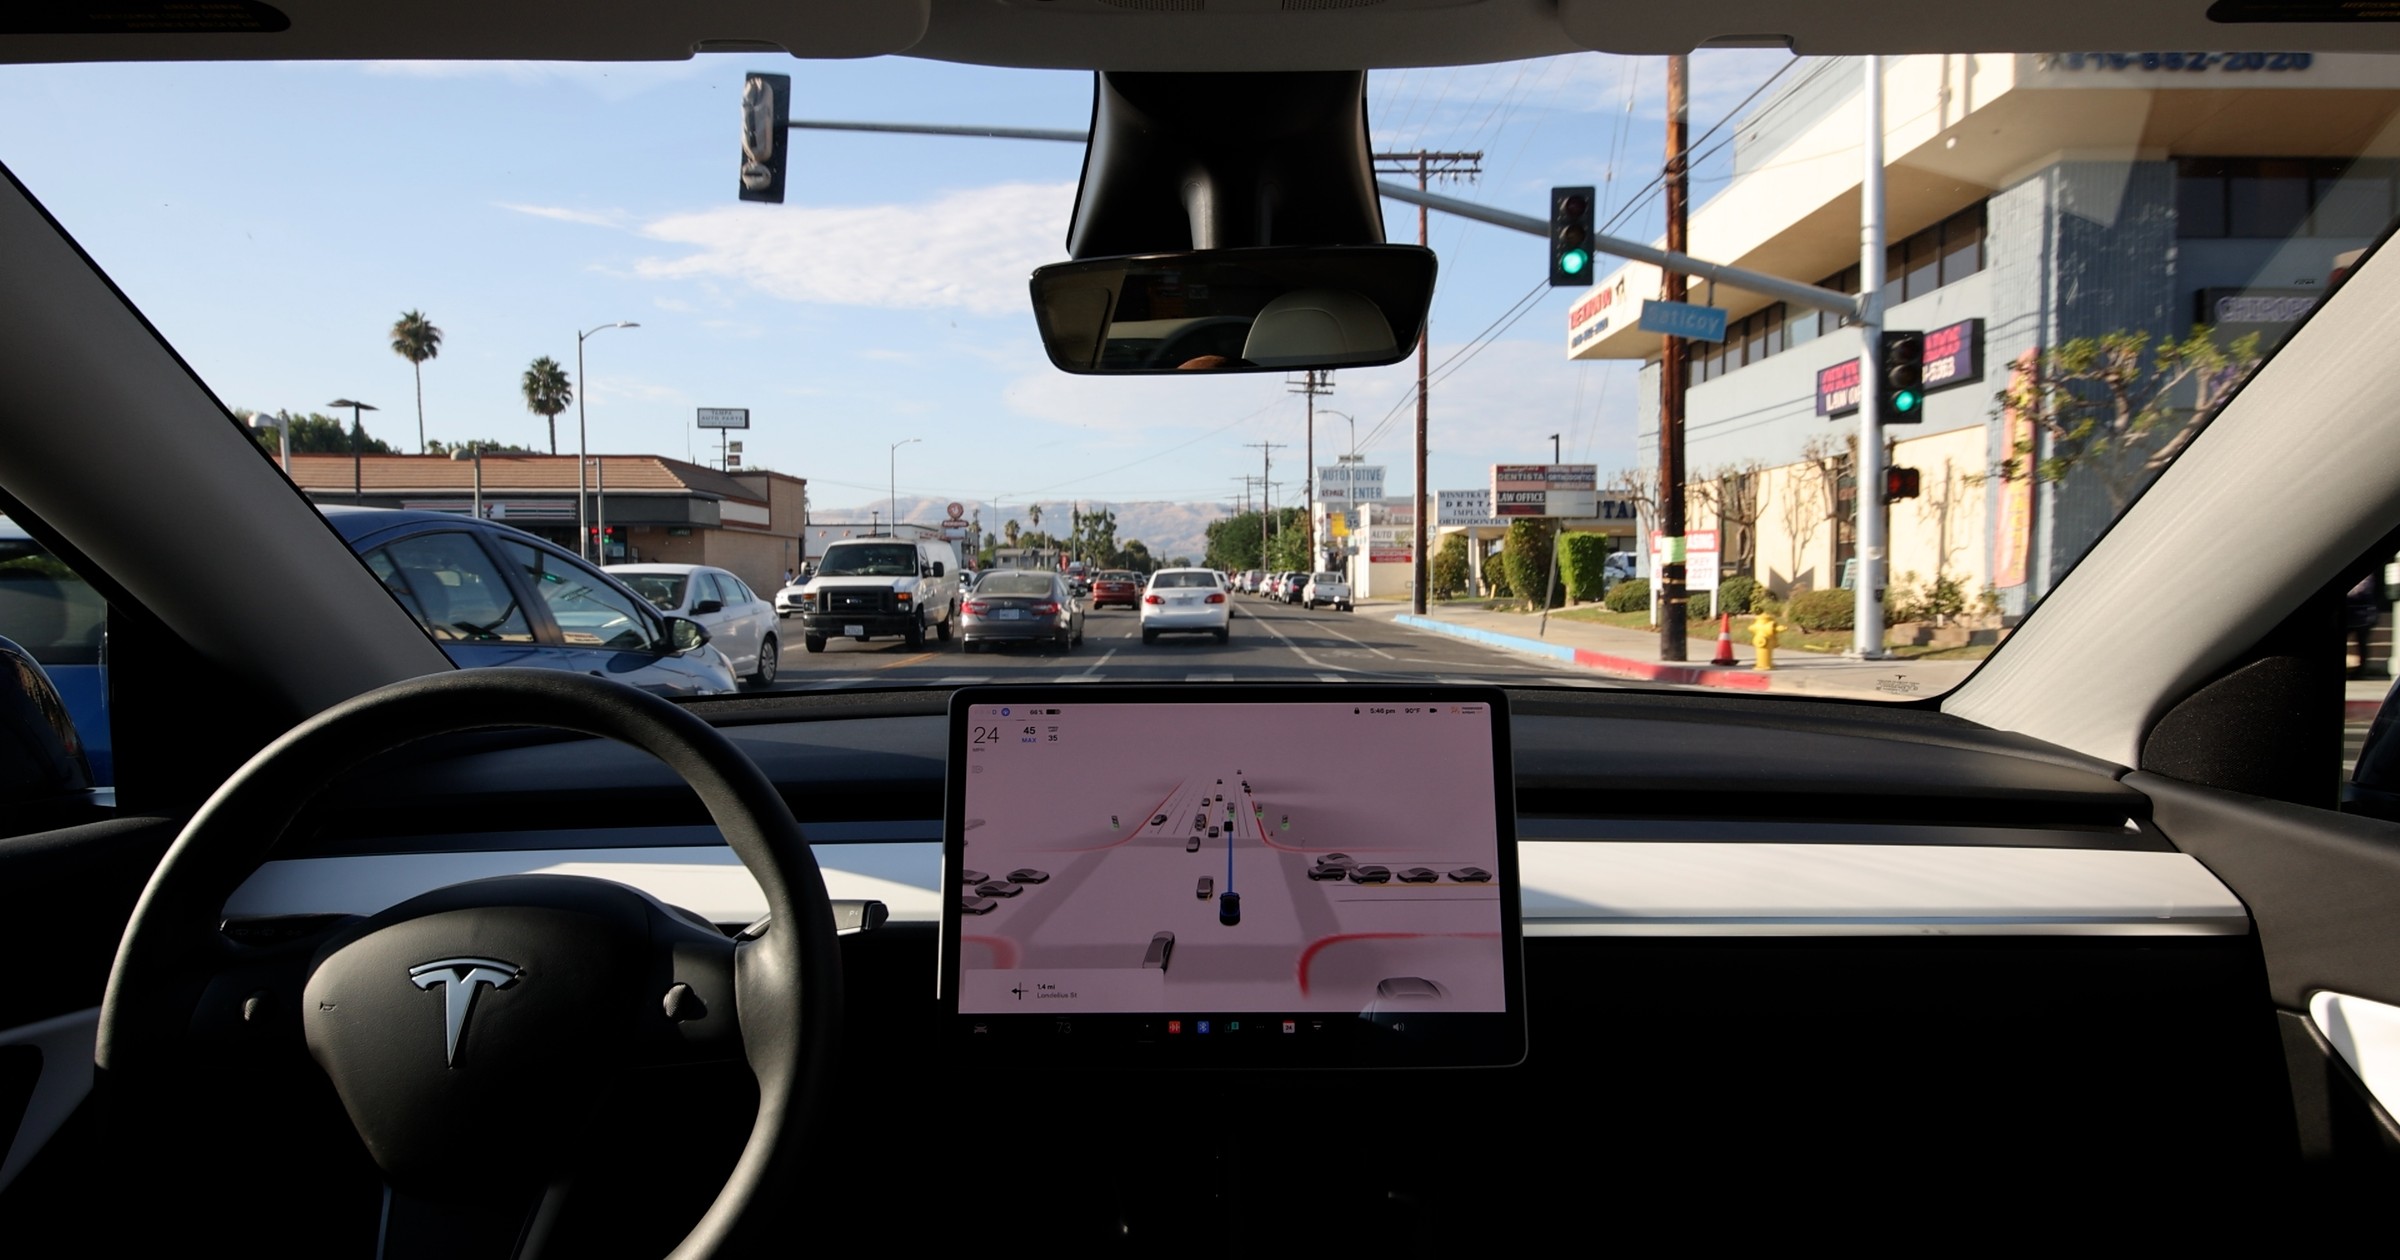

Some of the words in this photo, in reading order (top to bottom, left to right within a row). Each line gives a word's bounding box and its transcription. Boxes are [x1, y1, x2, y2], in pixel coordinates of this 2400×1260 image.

[1647, 305, 1720, 335] Saticoy
[1497, 493, 1515, 502] LAW
[1516, 493, 1544, 502] OFFICE
[1347, 519, 1359, 527] 35
[1372, 530, 1392, 538] AUTO
[973, 726, 999, 744] 24
[1023, 726, 1036, 735] 45
[1056, 1021, 1071, 1034] 73
